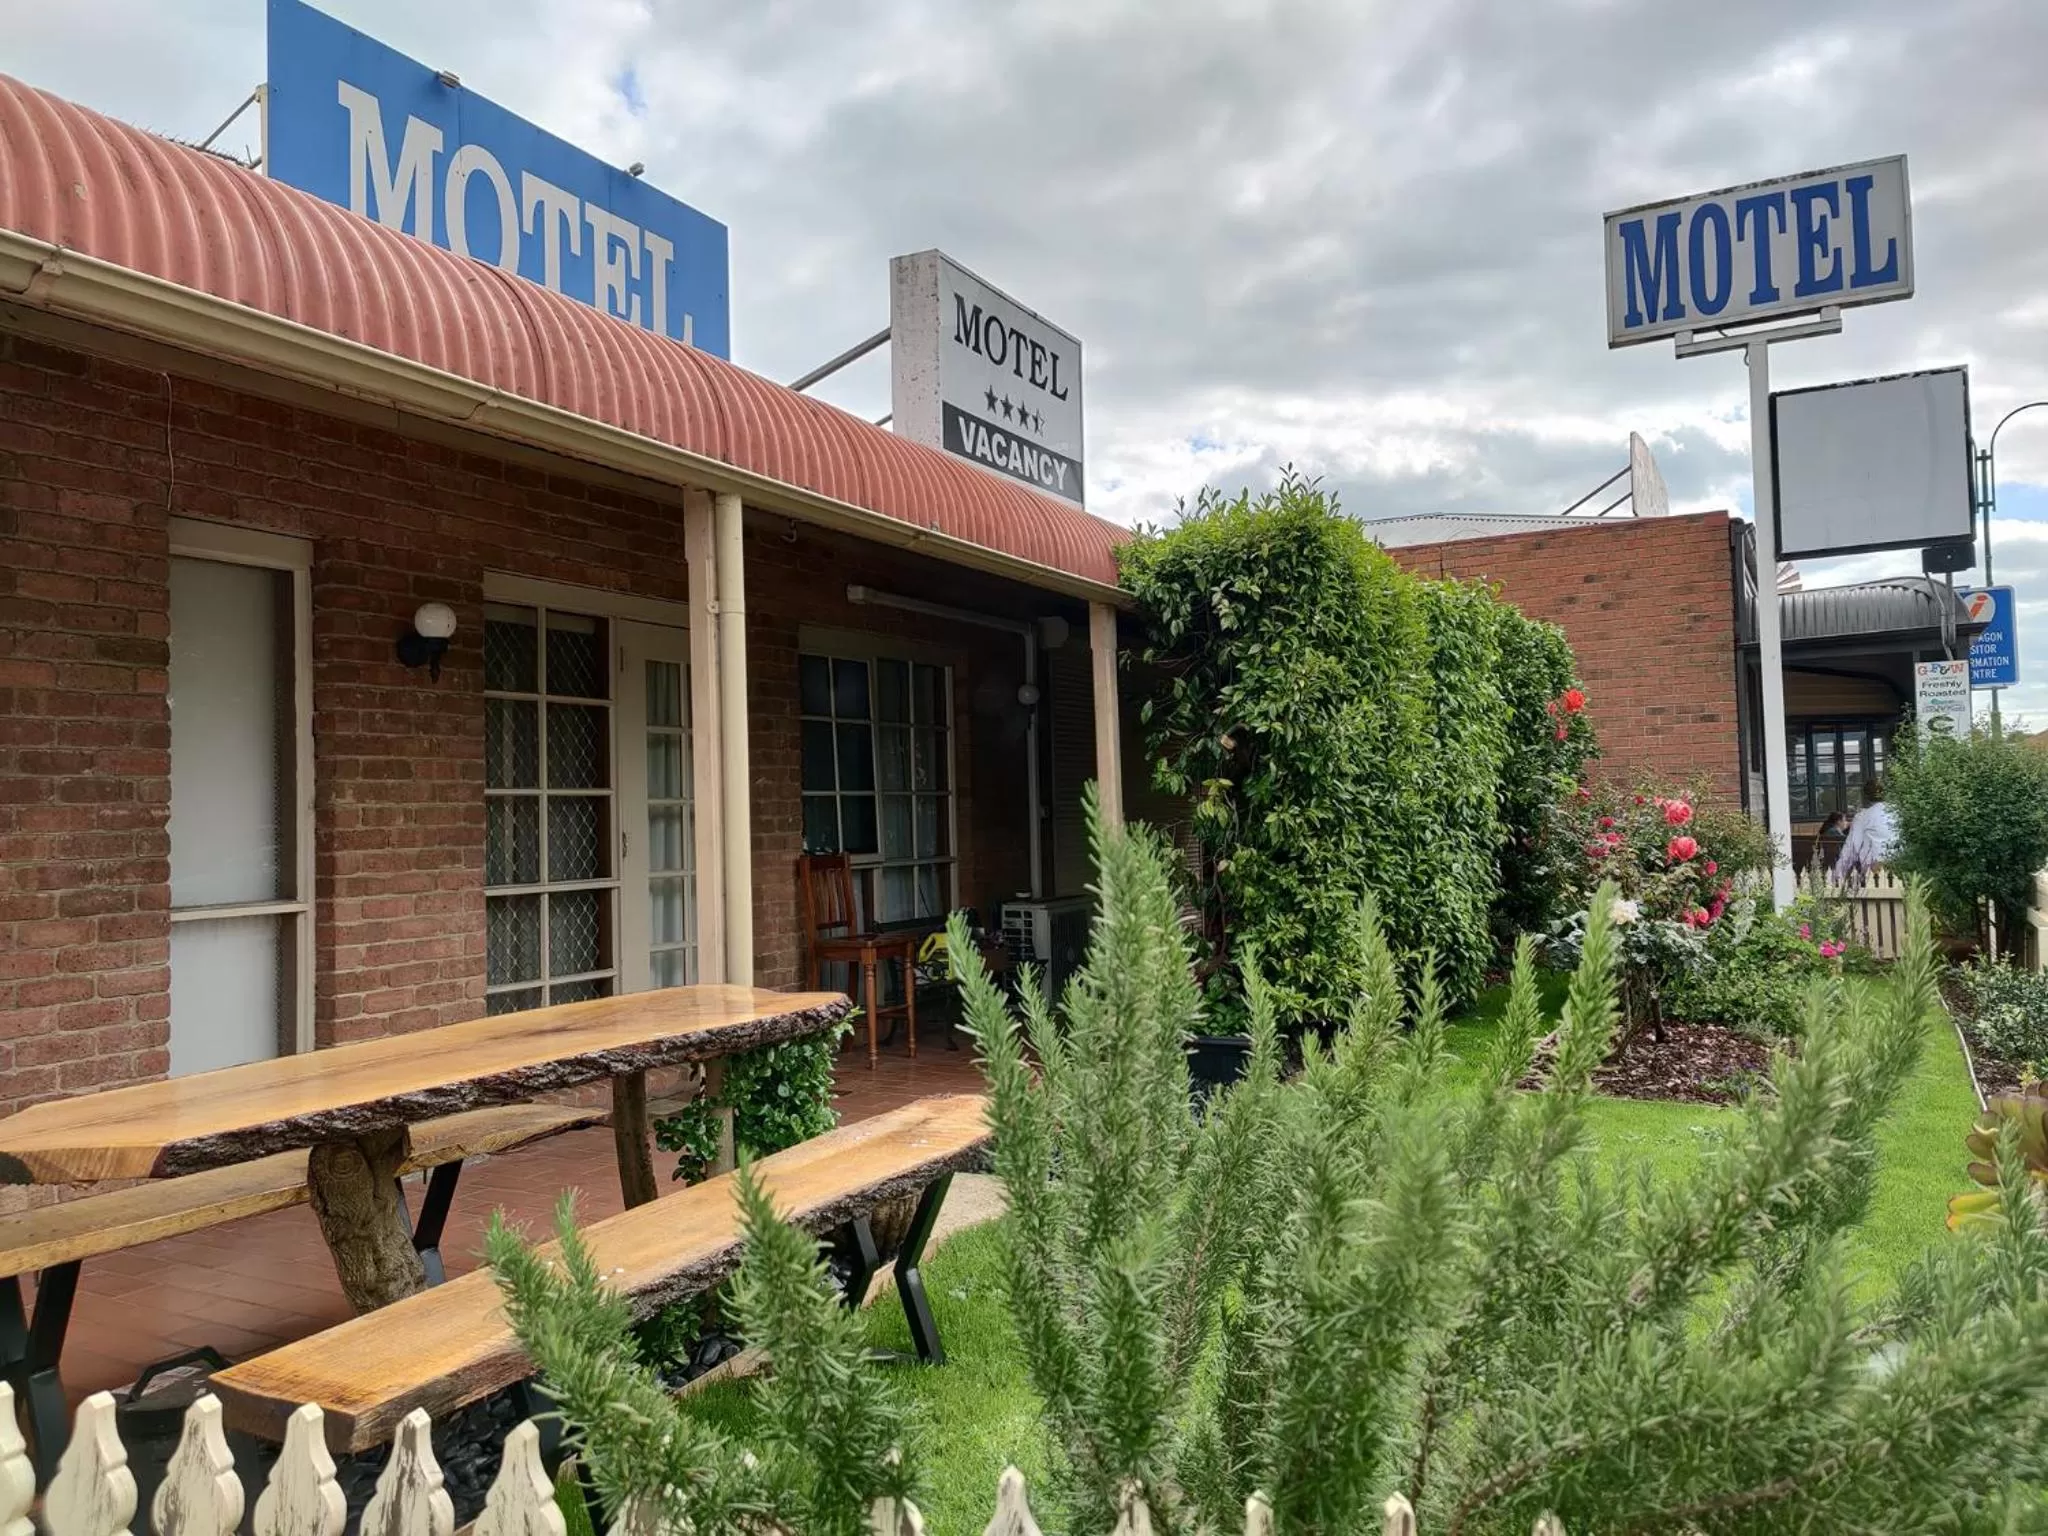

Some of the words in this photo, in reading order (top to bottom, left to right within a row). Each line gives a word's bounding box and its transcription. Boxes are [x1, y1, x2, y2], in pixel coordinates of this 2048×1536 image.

[338, 80, 694, 344] MOTEL
[1618, 174, 1899, 329] MOTEL
[954, 292, 1069, 402] MOTEL
[958, 416, 1068, 490] VACANCY
[1978, 632, 2003, 642] AGON
[1969, 644, 1997, 655] SITOR
[1969, 656, 2010, 668] RMATION
[1971, 668, 1998, 679] NTRE
[1922, 680, 1962, 688] Freshly
[1919, 688, 1967, 697] Roasted
